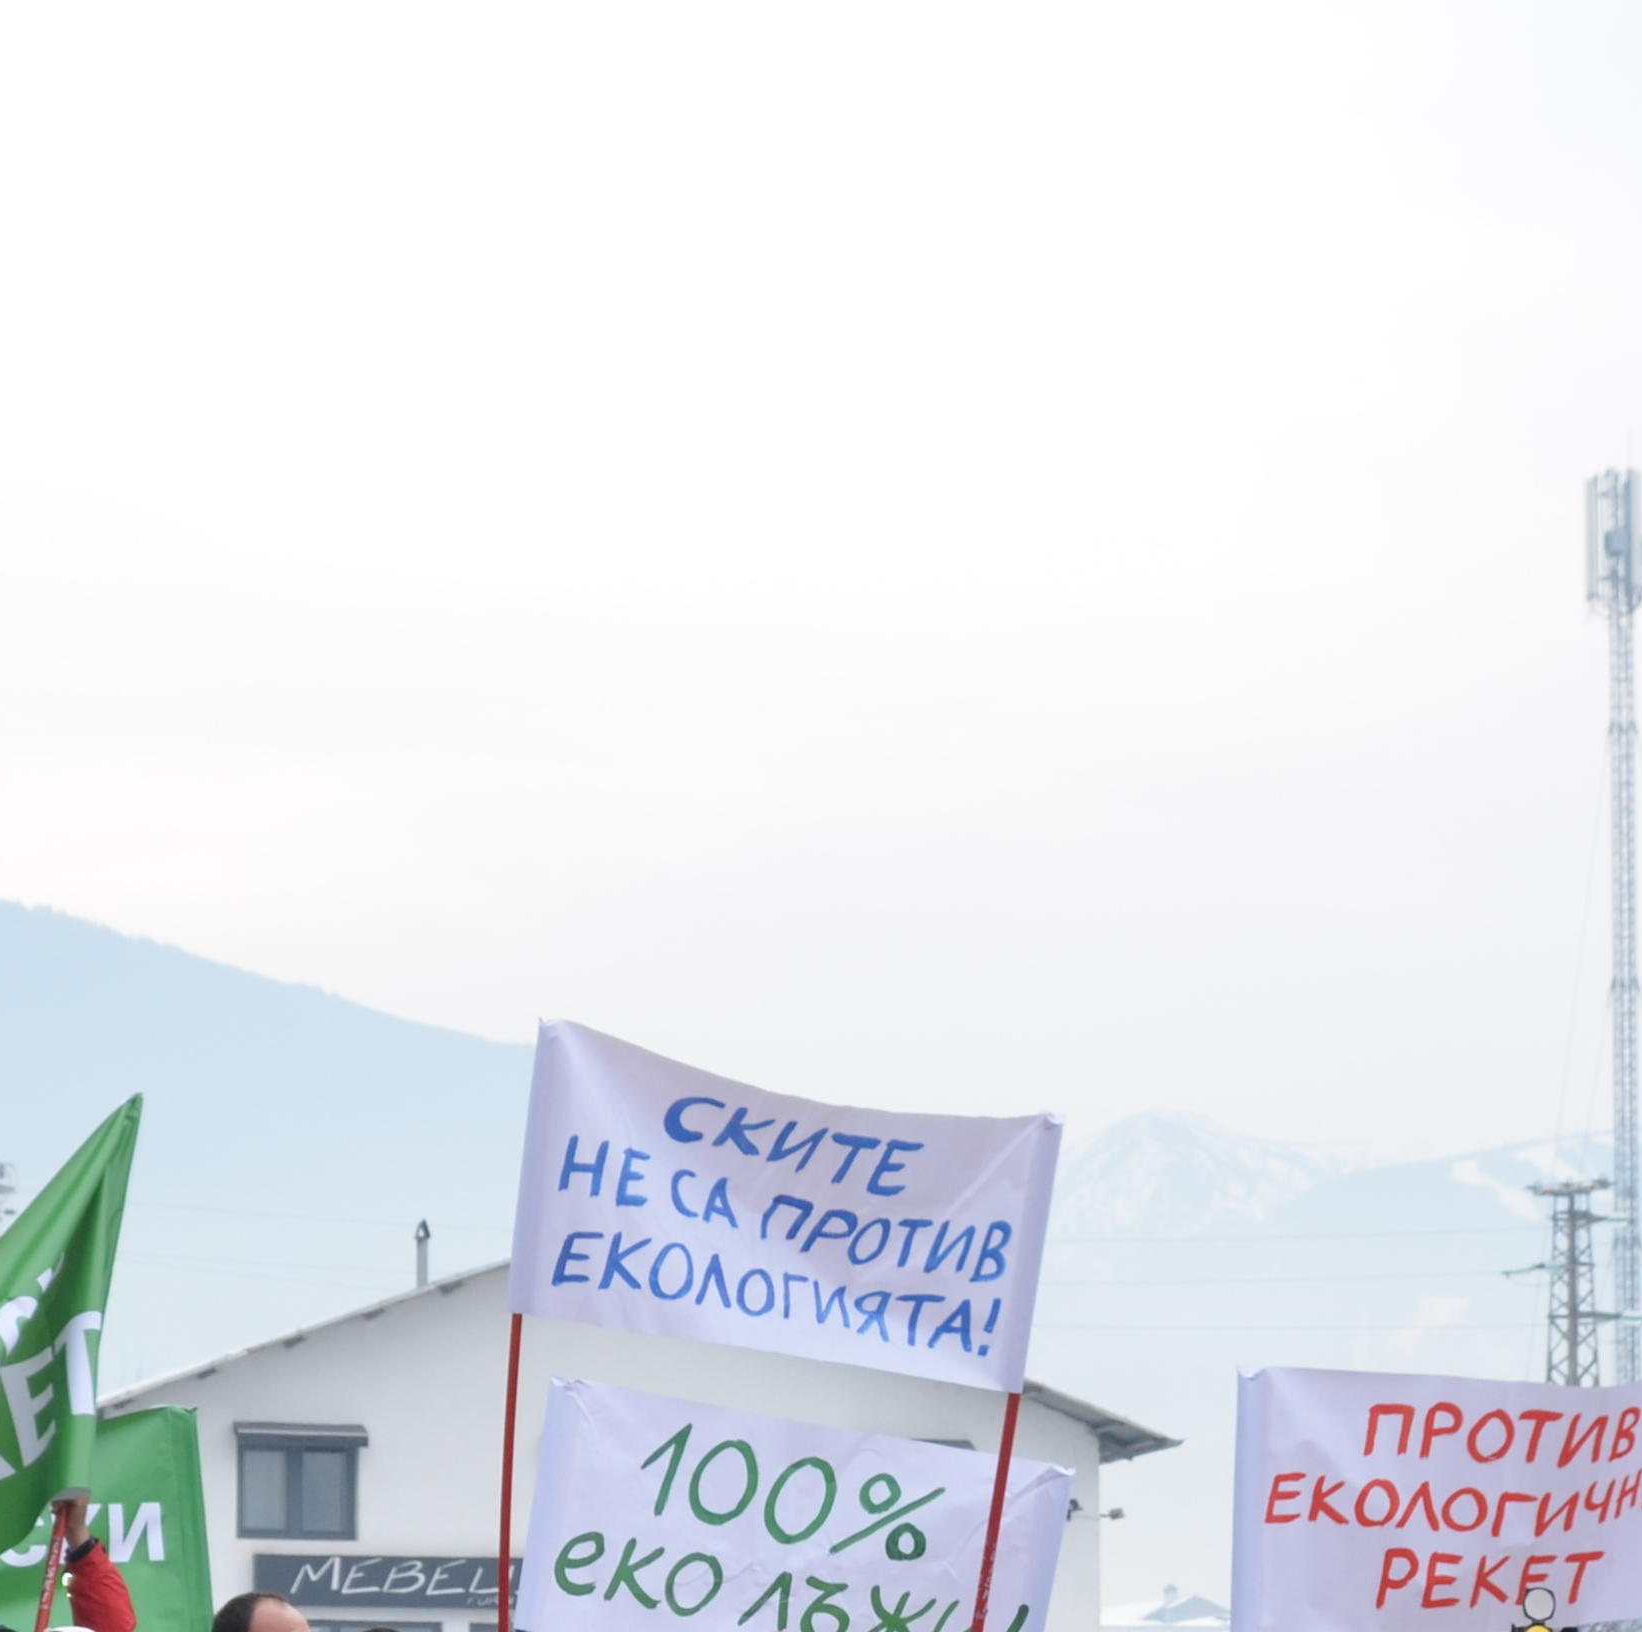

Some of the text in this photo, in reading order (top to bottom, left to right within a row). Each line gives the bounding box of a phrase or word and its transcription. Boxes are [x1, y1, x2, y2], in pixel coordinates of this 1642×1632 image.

[663, 1097, 923, 1197] СКИТЕ
[558, 1136, 1012, 1284] НЕ СА ПРОТИВ
[552, 1232, 1001, 1356] ЕКОЛОГИЯТА!
[1363, 1402, 1642, 1468] ПРОТИВ
[641, 1424, 945, 1561] 100%
[1375, 1548, 1605, 1609] РЕКЕТ
